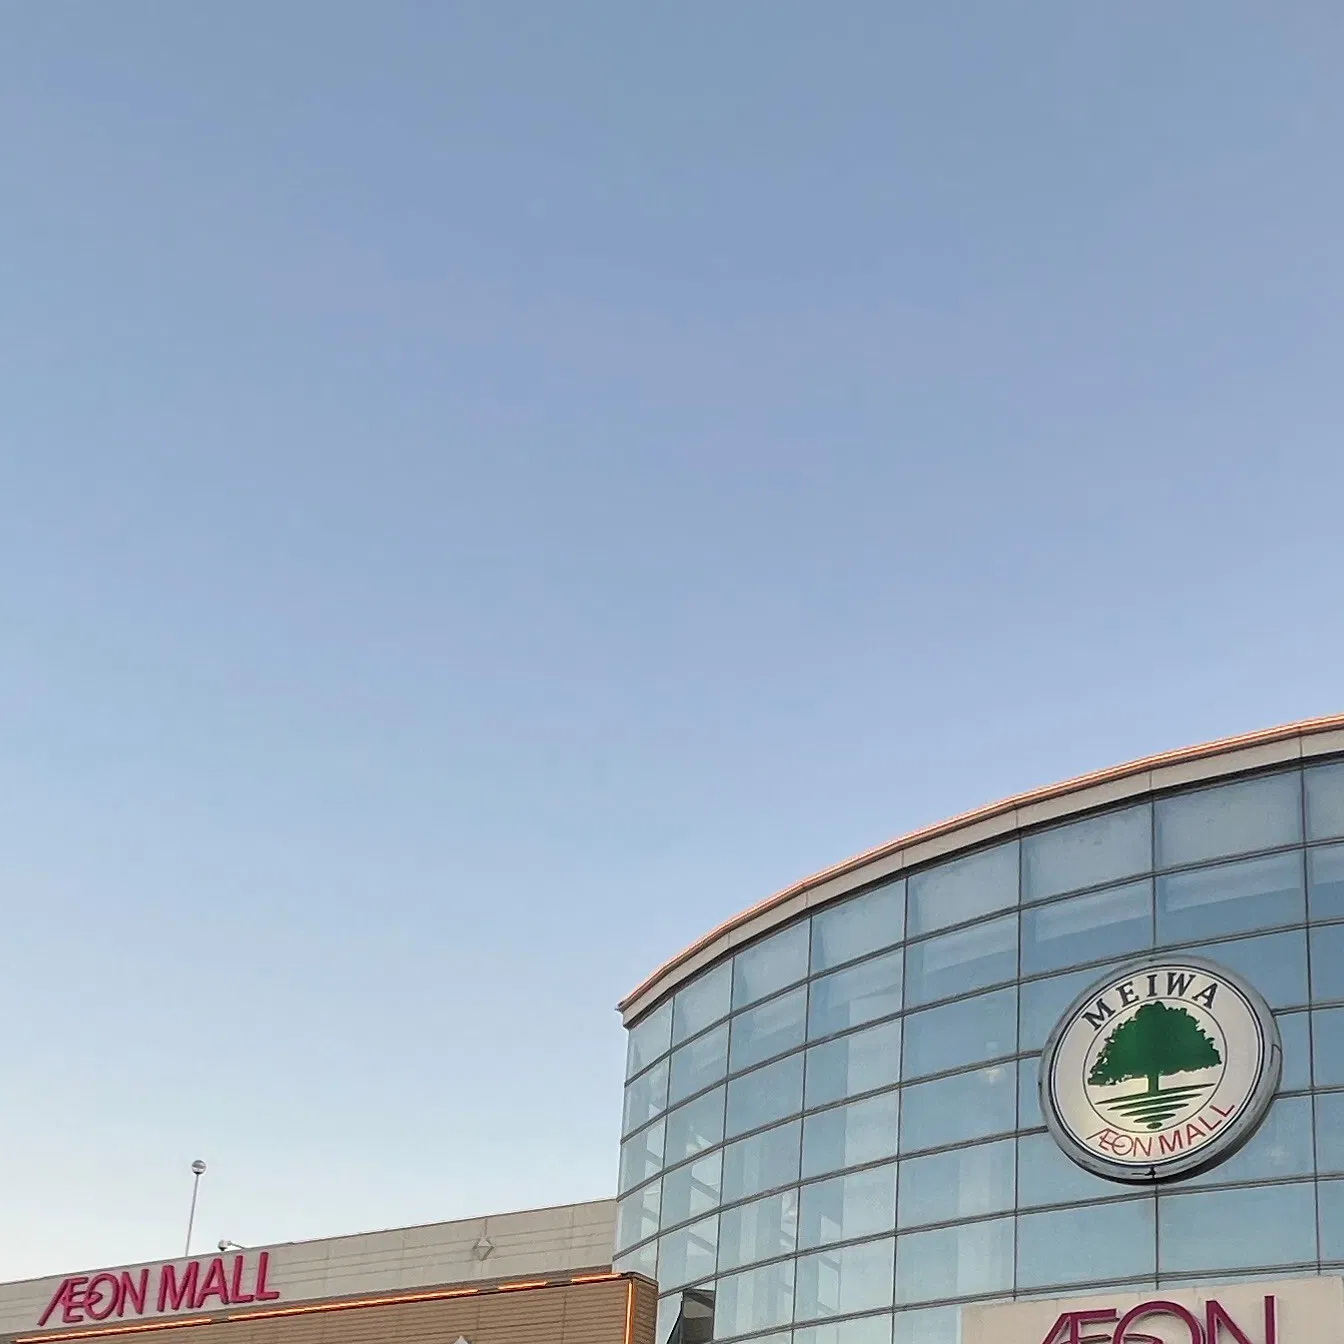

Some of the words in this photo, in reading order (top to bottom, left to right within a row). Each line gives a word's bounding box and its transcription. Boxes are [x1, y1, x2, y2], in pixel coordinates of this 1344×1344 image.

[1081, 972, 1219, 1031] MEIWA
[1158, 1104, 1236, 1155] MALL
[156, 1252, 280, 1313] MALL
